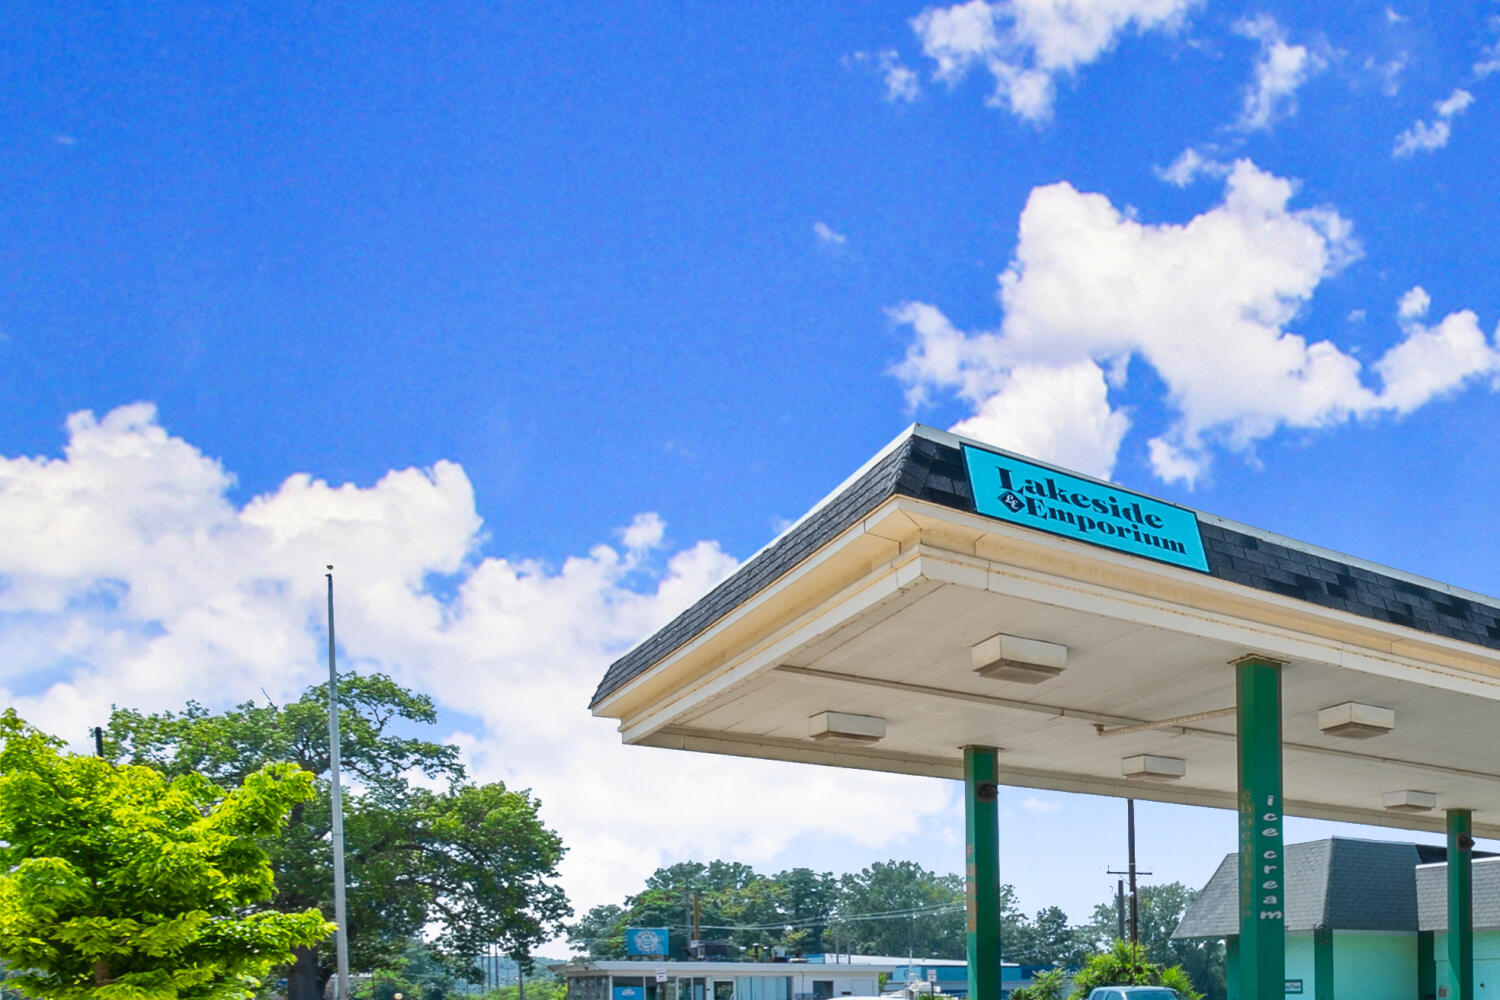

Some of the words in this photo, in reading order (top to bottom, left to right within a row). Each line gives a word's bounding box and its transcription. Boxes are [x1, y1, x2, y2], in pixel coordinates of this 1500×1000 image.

[997, 465, 1165, 529] Lakeside
[1027, 498, 1187, 555] Emporium
[1261, 795, 1279, 837] ice
[1260, 850, 1283, 920] cream
